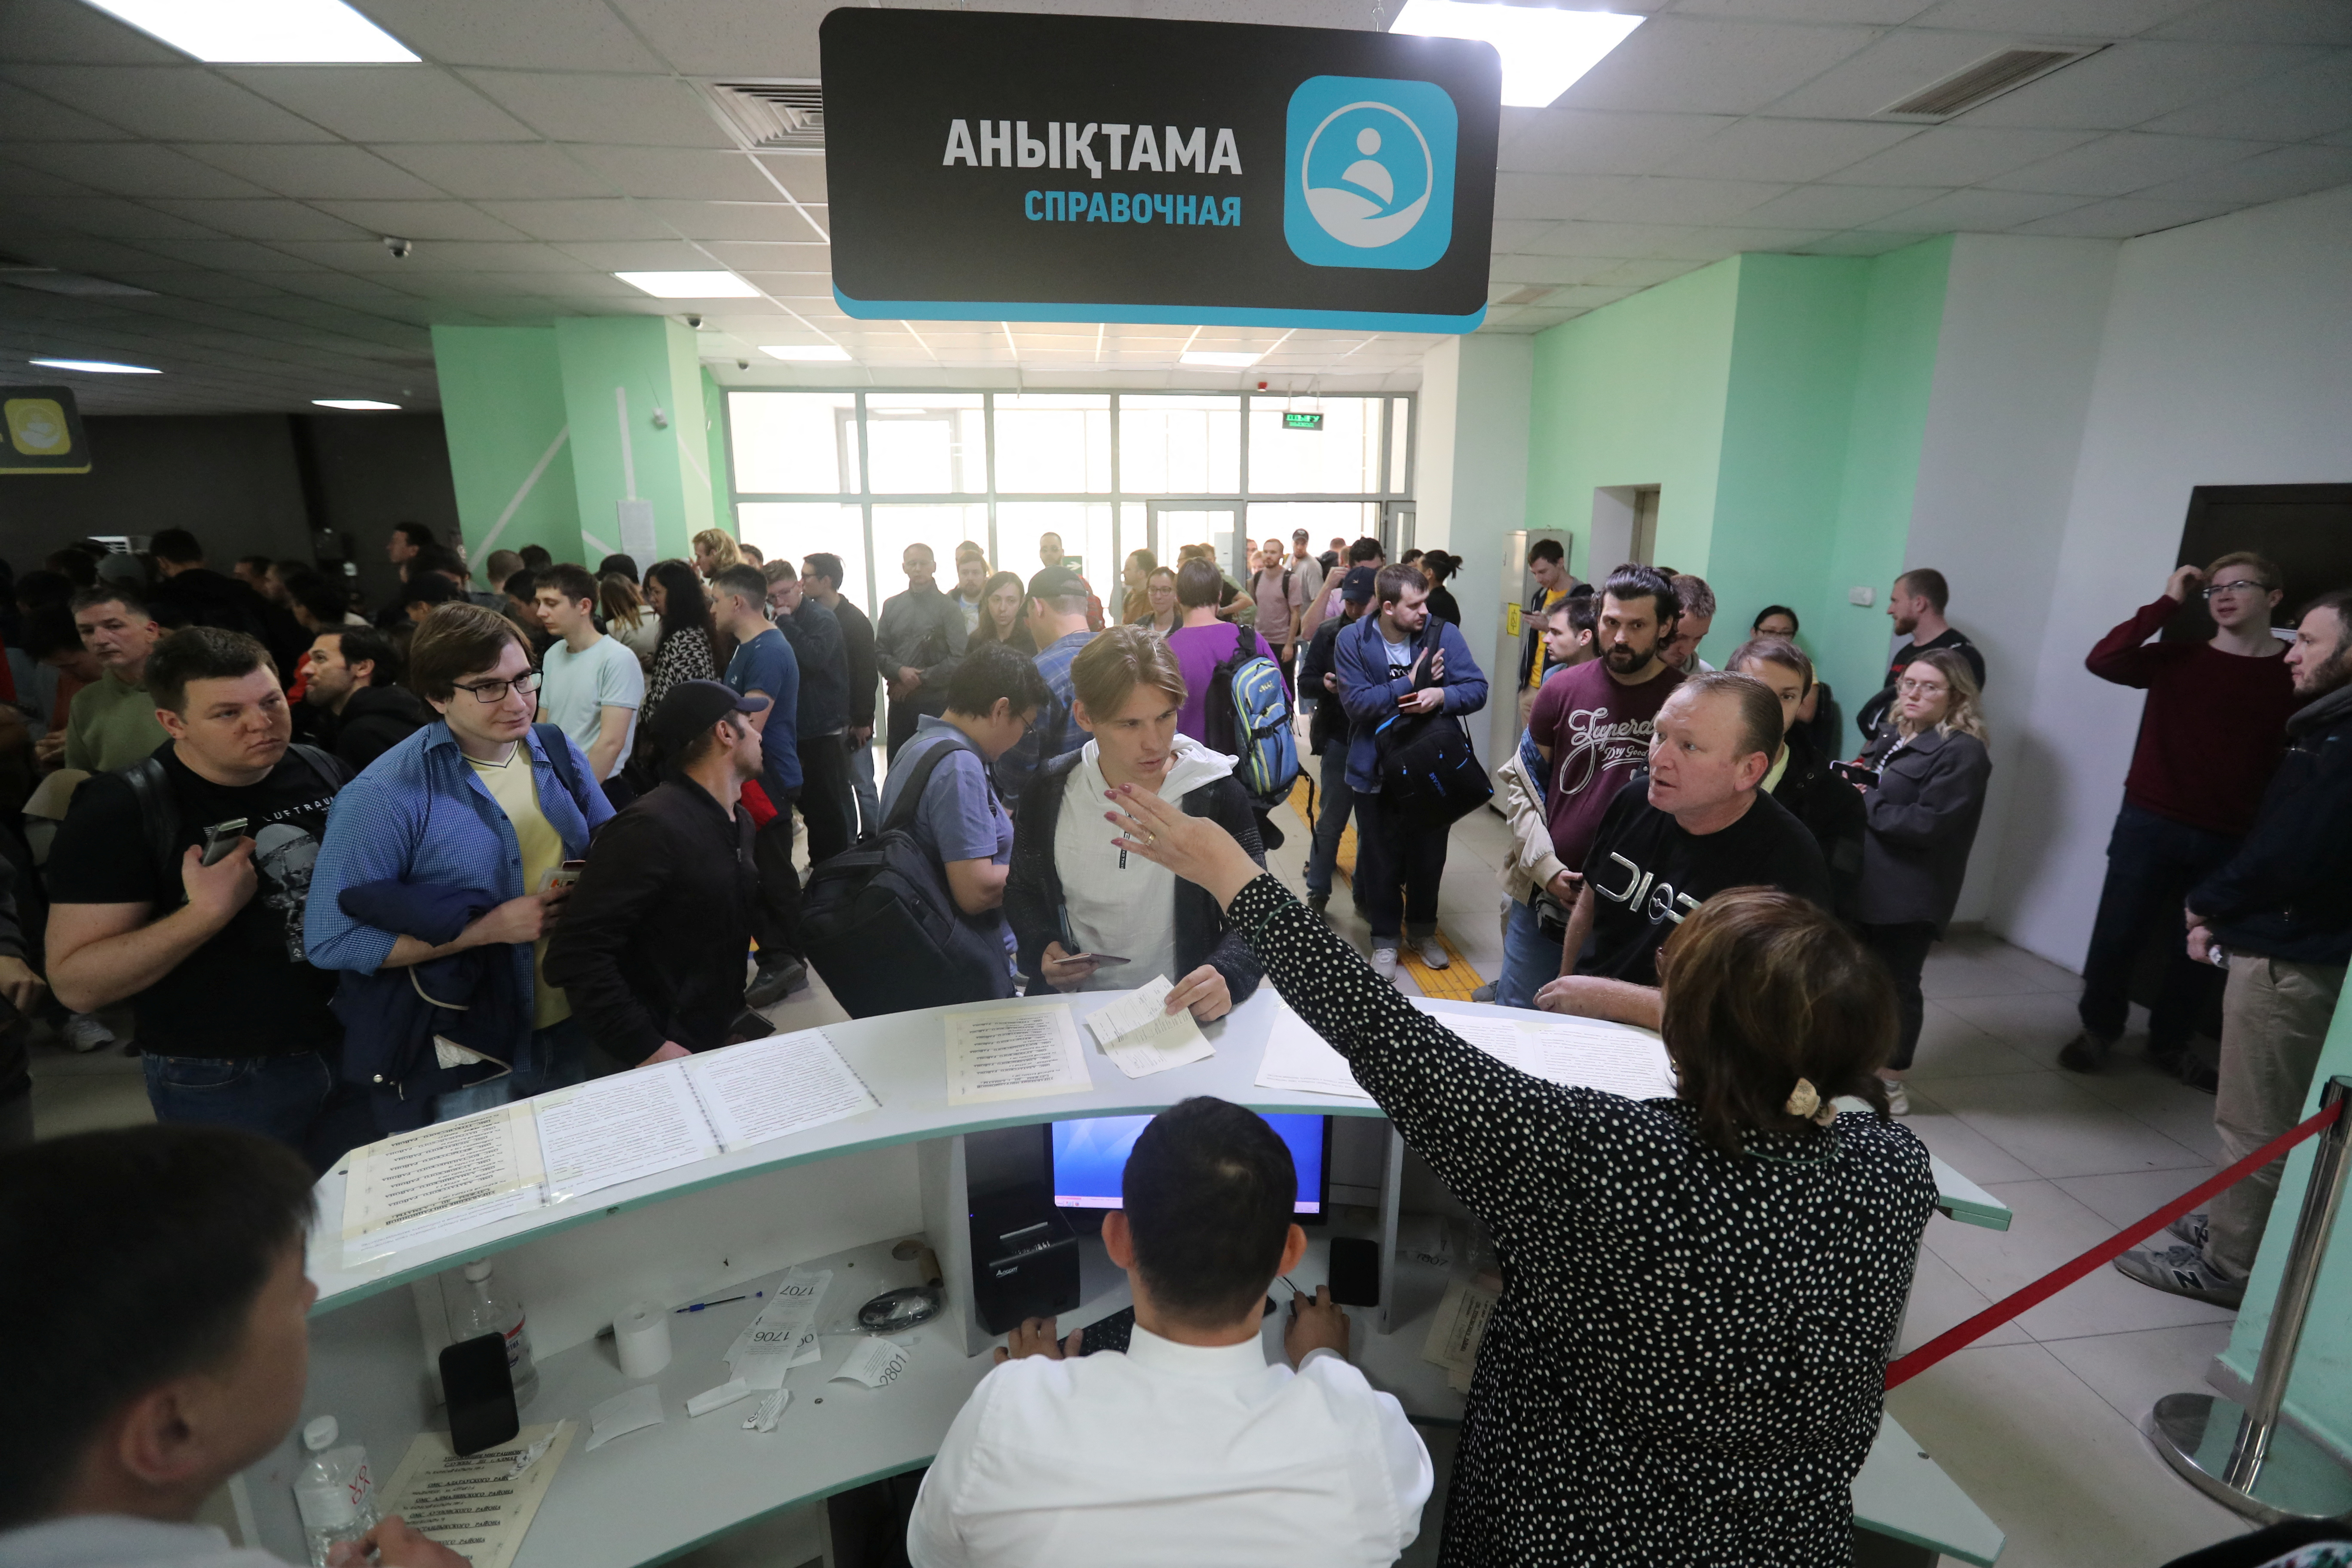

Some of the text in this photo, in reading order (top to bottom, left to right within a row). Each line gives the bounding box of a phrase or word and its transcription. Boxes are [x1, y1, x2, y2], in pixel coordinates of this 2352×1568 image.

[942, 119, 1243, 178] АНЫҚТАМА
[1024, 190, 1241, 227] СПРАВОЧНАЯ
[1559, 707, 1654, 795] Superd
[1602, 745, 1648, 762] Dry Good
[263, 796, 334, 822] LUFTRAU
[780, 1285, 815, 1296] 1707
[2173, 1269, 2206, 1290] N
[753, 1331, 790, 1342] 1706
[879, 1353, 906, 1386] 2801
[484, 1450, 522, 1458] МИГРАЦИОН
